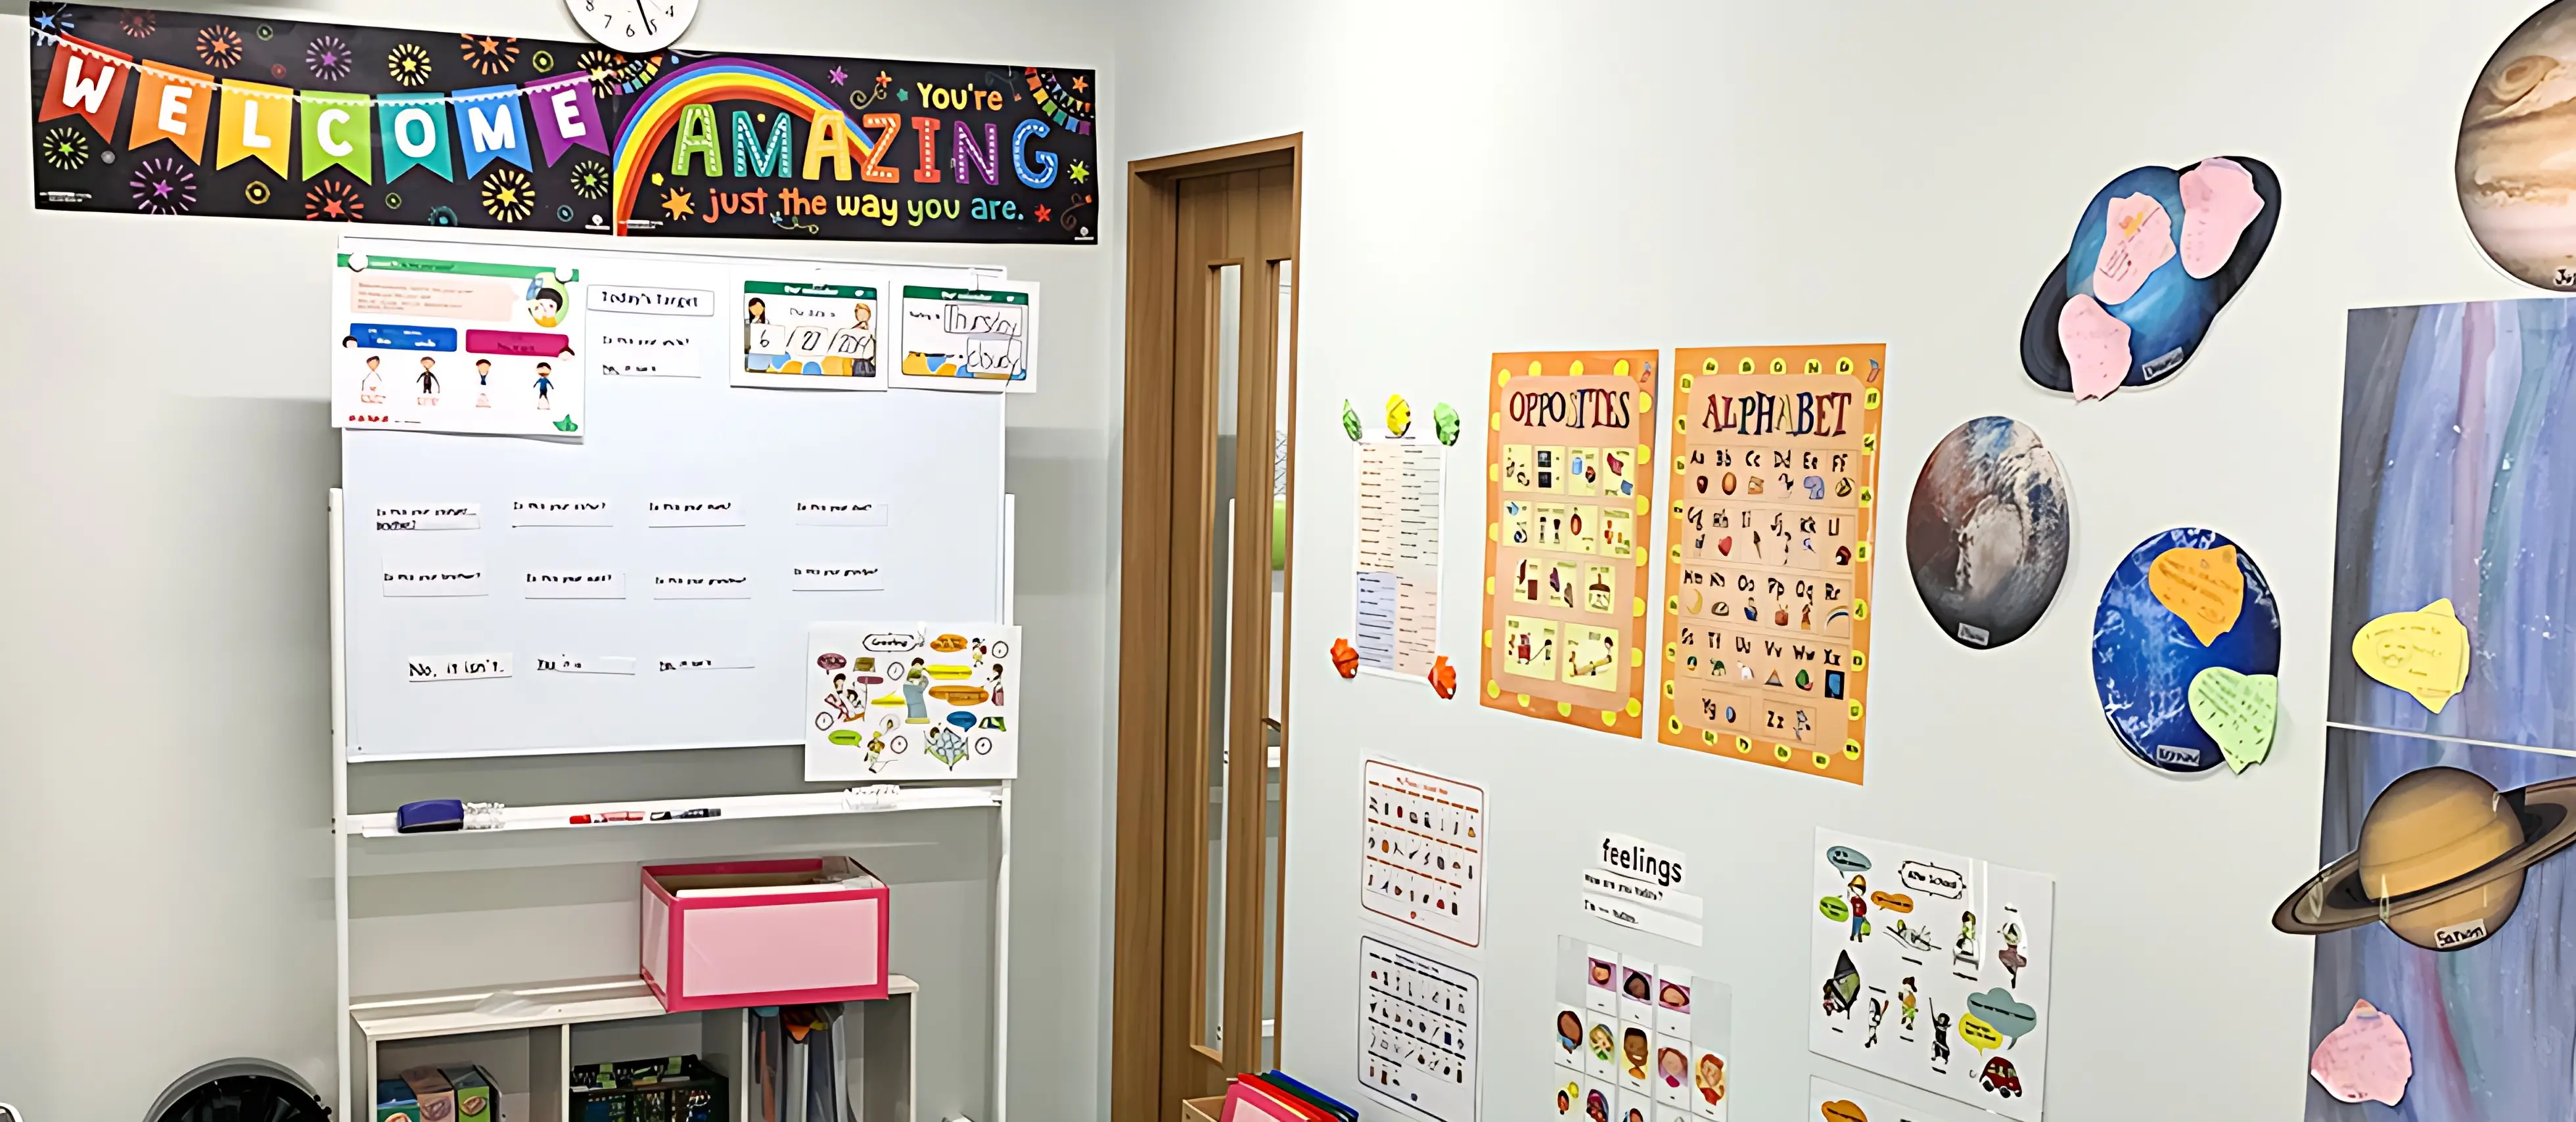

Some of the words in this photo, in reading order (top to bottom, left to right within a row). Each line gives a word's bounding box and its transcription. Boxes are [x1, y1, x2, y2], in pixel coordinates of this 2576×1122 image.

[604, 14, 612, 28] 7
[626, 24, 635, 37] 6
[650, 18, 657, 32] 5
[62, 54, 587, 152] WELCOME
[917, 81, 1003, 110] You're
[671, 104, 1059, 189] AMAZING
[702, 187, 768, 223] just
[779, 187, 827, 215] the
[837, 196, 898, 225] way
[908, 198, 959, 226] you
[971, 197, 1024, 221] are.
[760, 329, 770, 348] 6
[1509, 388, 1630, 428] OPPOSITES
[1702, 391, 1852, 437] ALPHABET
[1765, 640, 1783, 658] Vv
[1767, 710, 1785, 729] Zz
[1602, 838, 1682, 886] feelings
